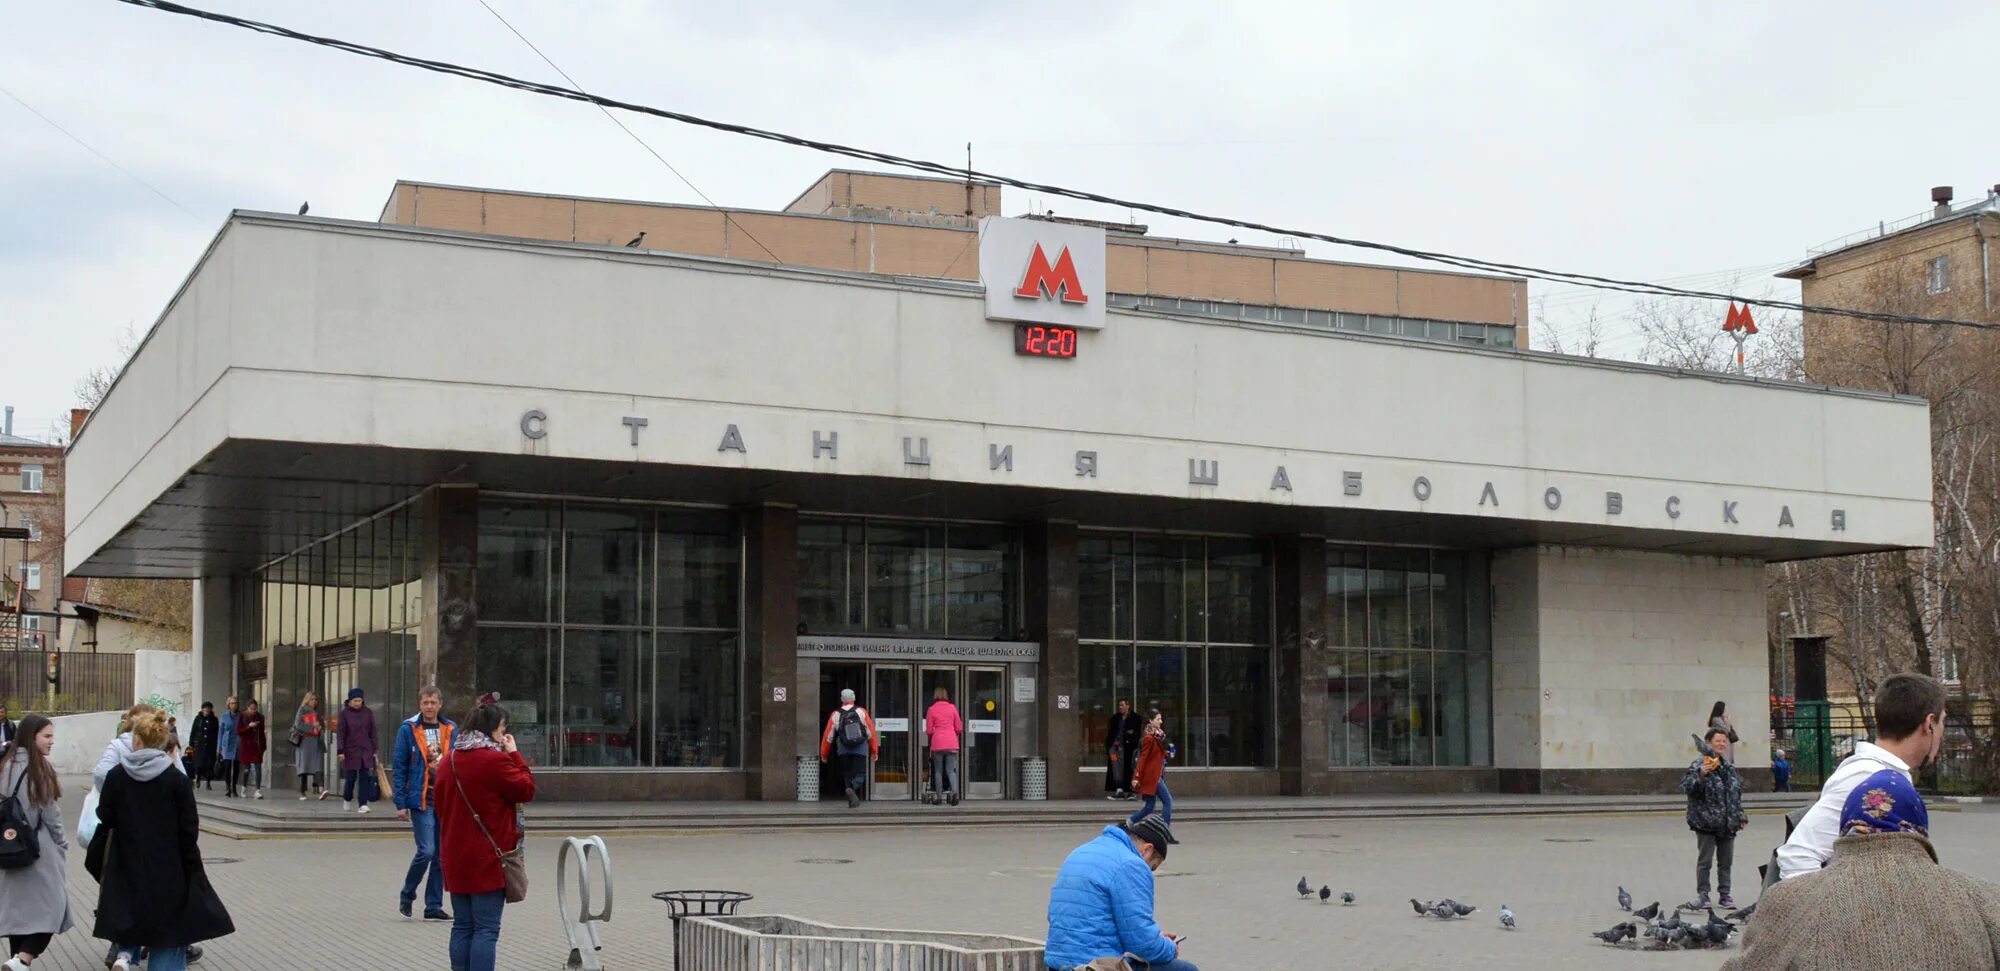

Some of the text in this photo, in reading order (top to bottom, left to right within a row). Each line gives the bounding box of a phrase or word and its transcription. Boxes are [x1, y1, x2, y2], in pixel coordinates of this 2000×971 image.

[1014, 240, 1088, 304] М
[1722, 298, 1759, 334] М
[521, 409, 1845, 531] СТАНЦИЯ ШАБОЛОВСКАЯ
[941, 646, 976, 656] СТАНЦИЯ
[978, 647, 1036, 656] ШАБОЛОВСКАЯ
